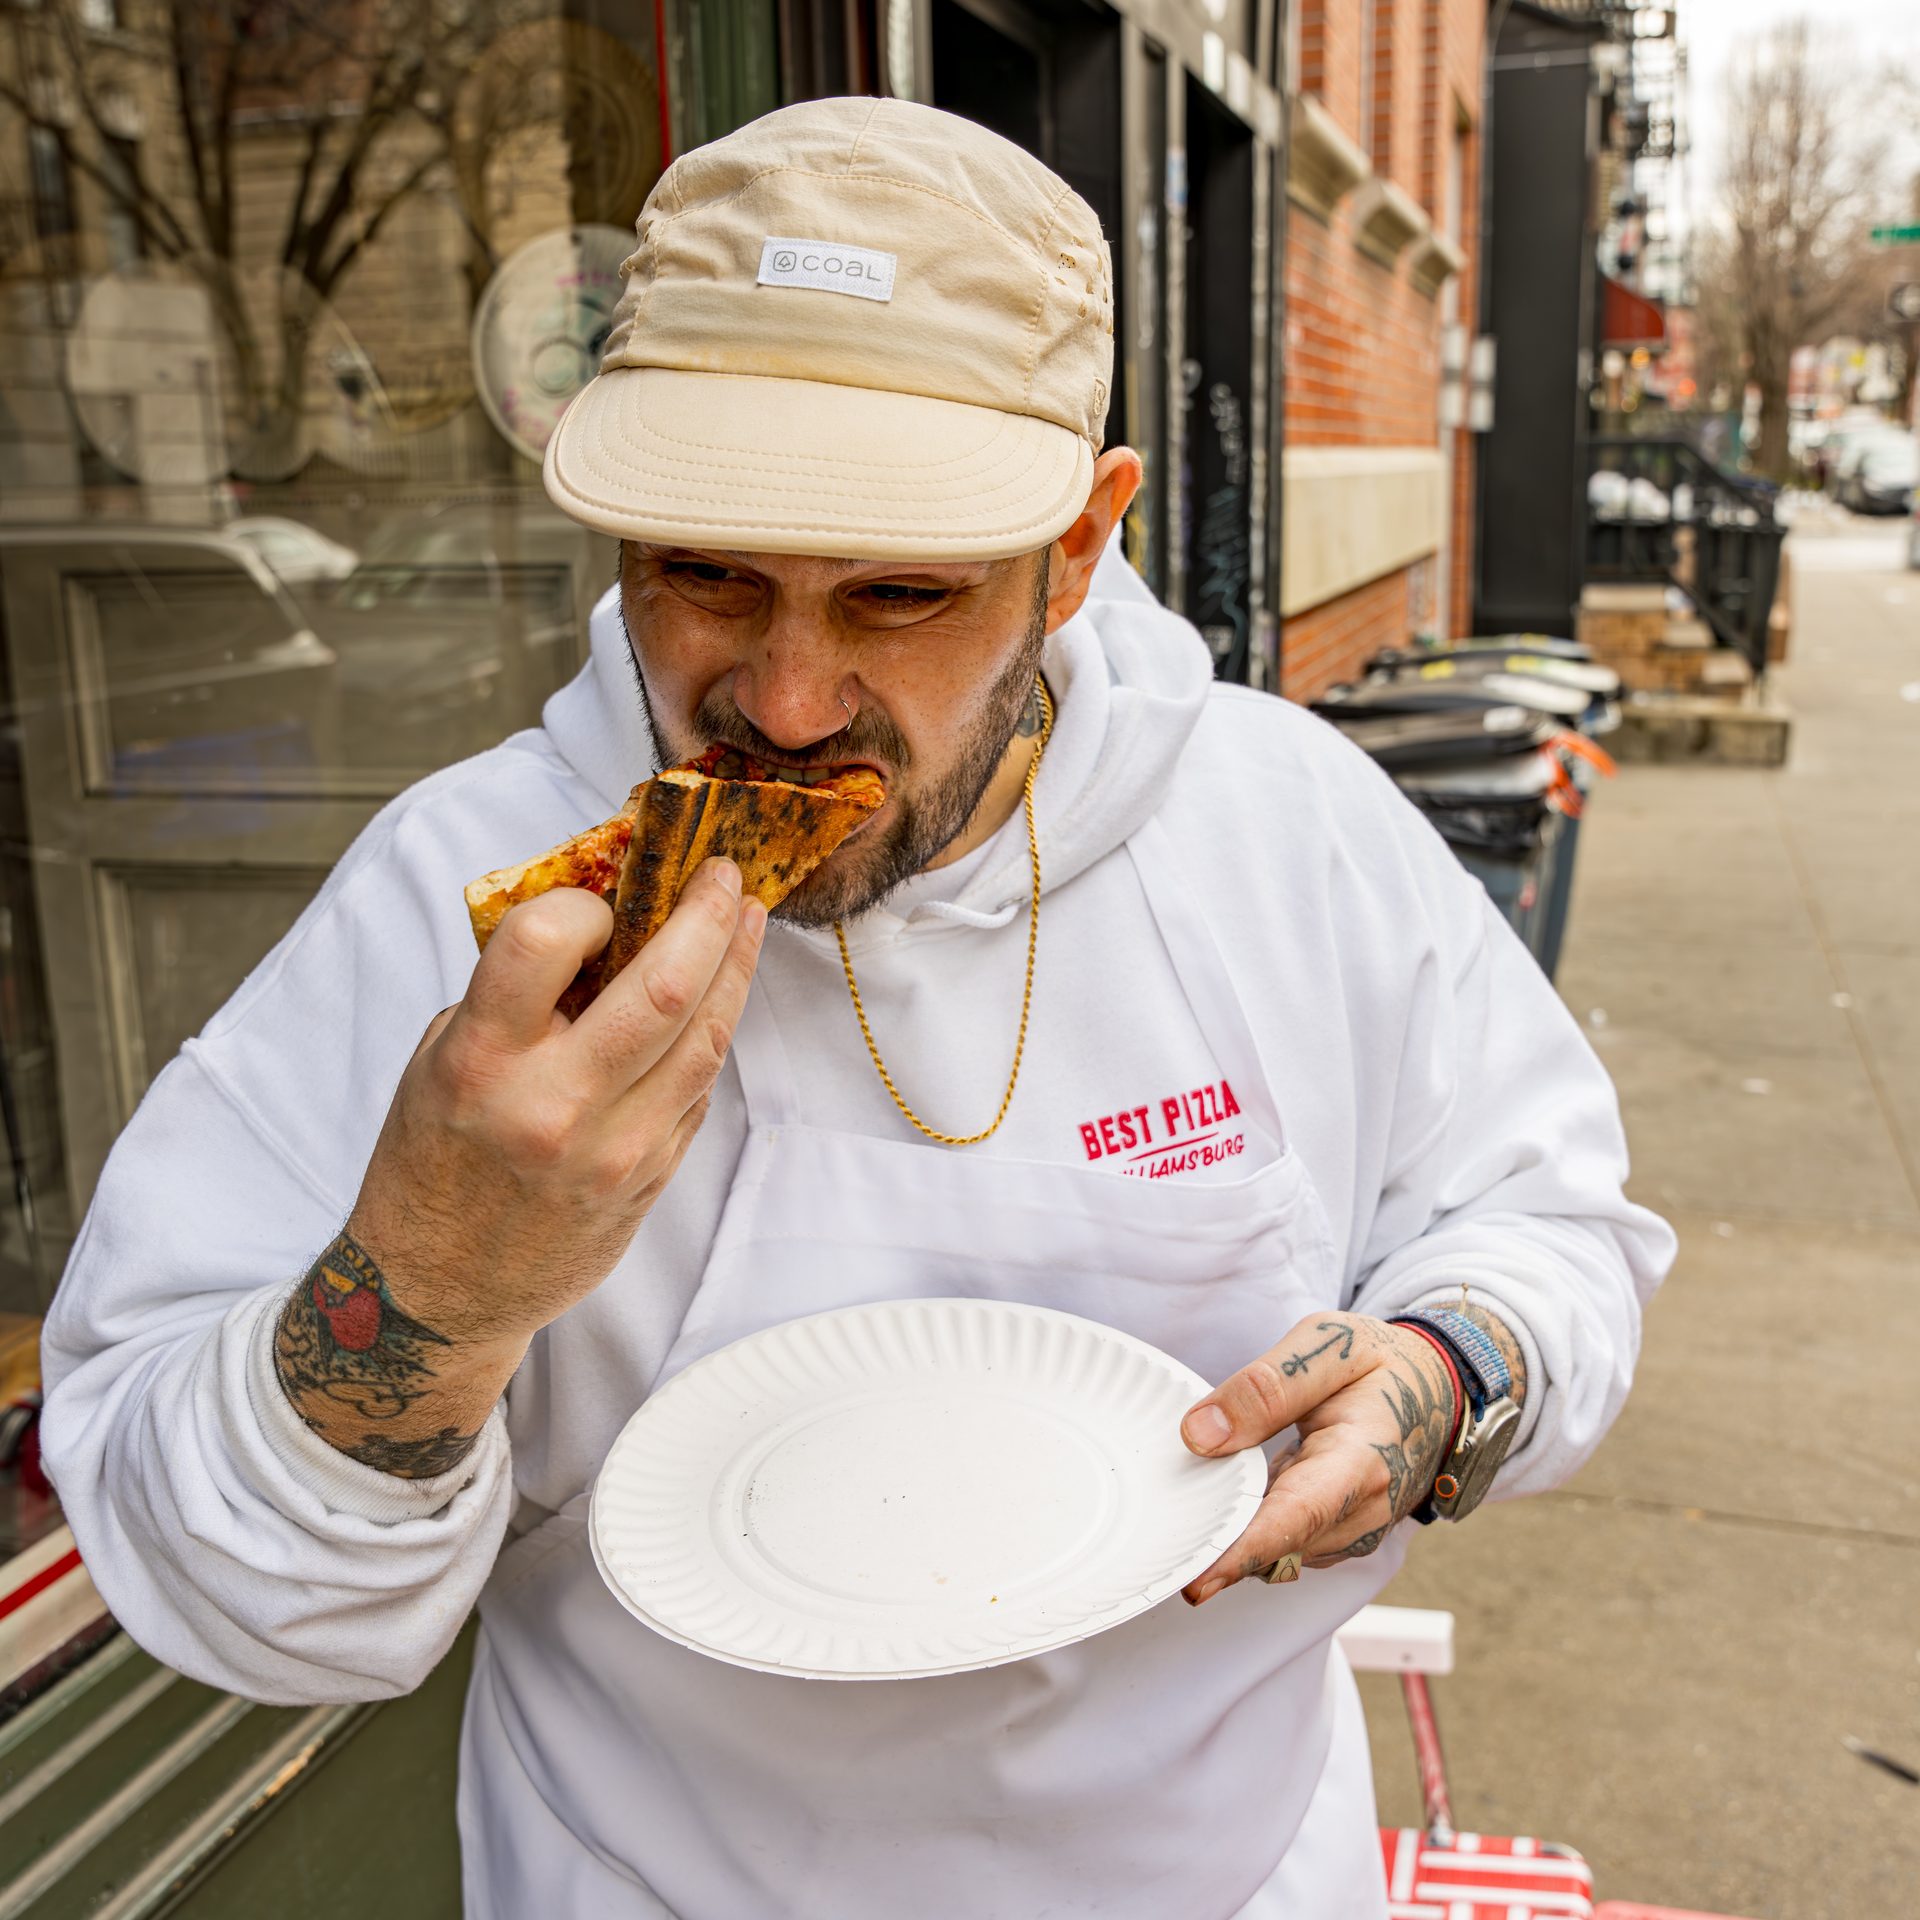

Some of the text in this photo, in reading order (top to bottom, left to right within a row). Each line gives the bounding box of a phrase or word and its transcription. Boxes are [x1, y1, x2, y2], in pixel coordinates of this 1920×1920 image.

[1079, 1080, 1241, 1161] BEST PIZZA
[1122, 1133, 1245, 1179] IAMSBURG
